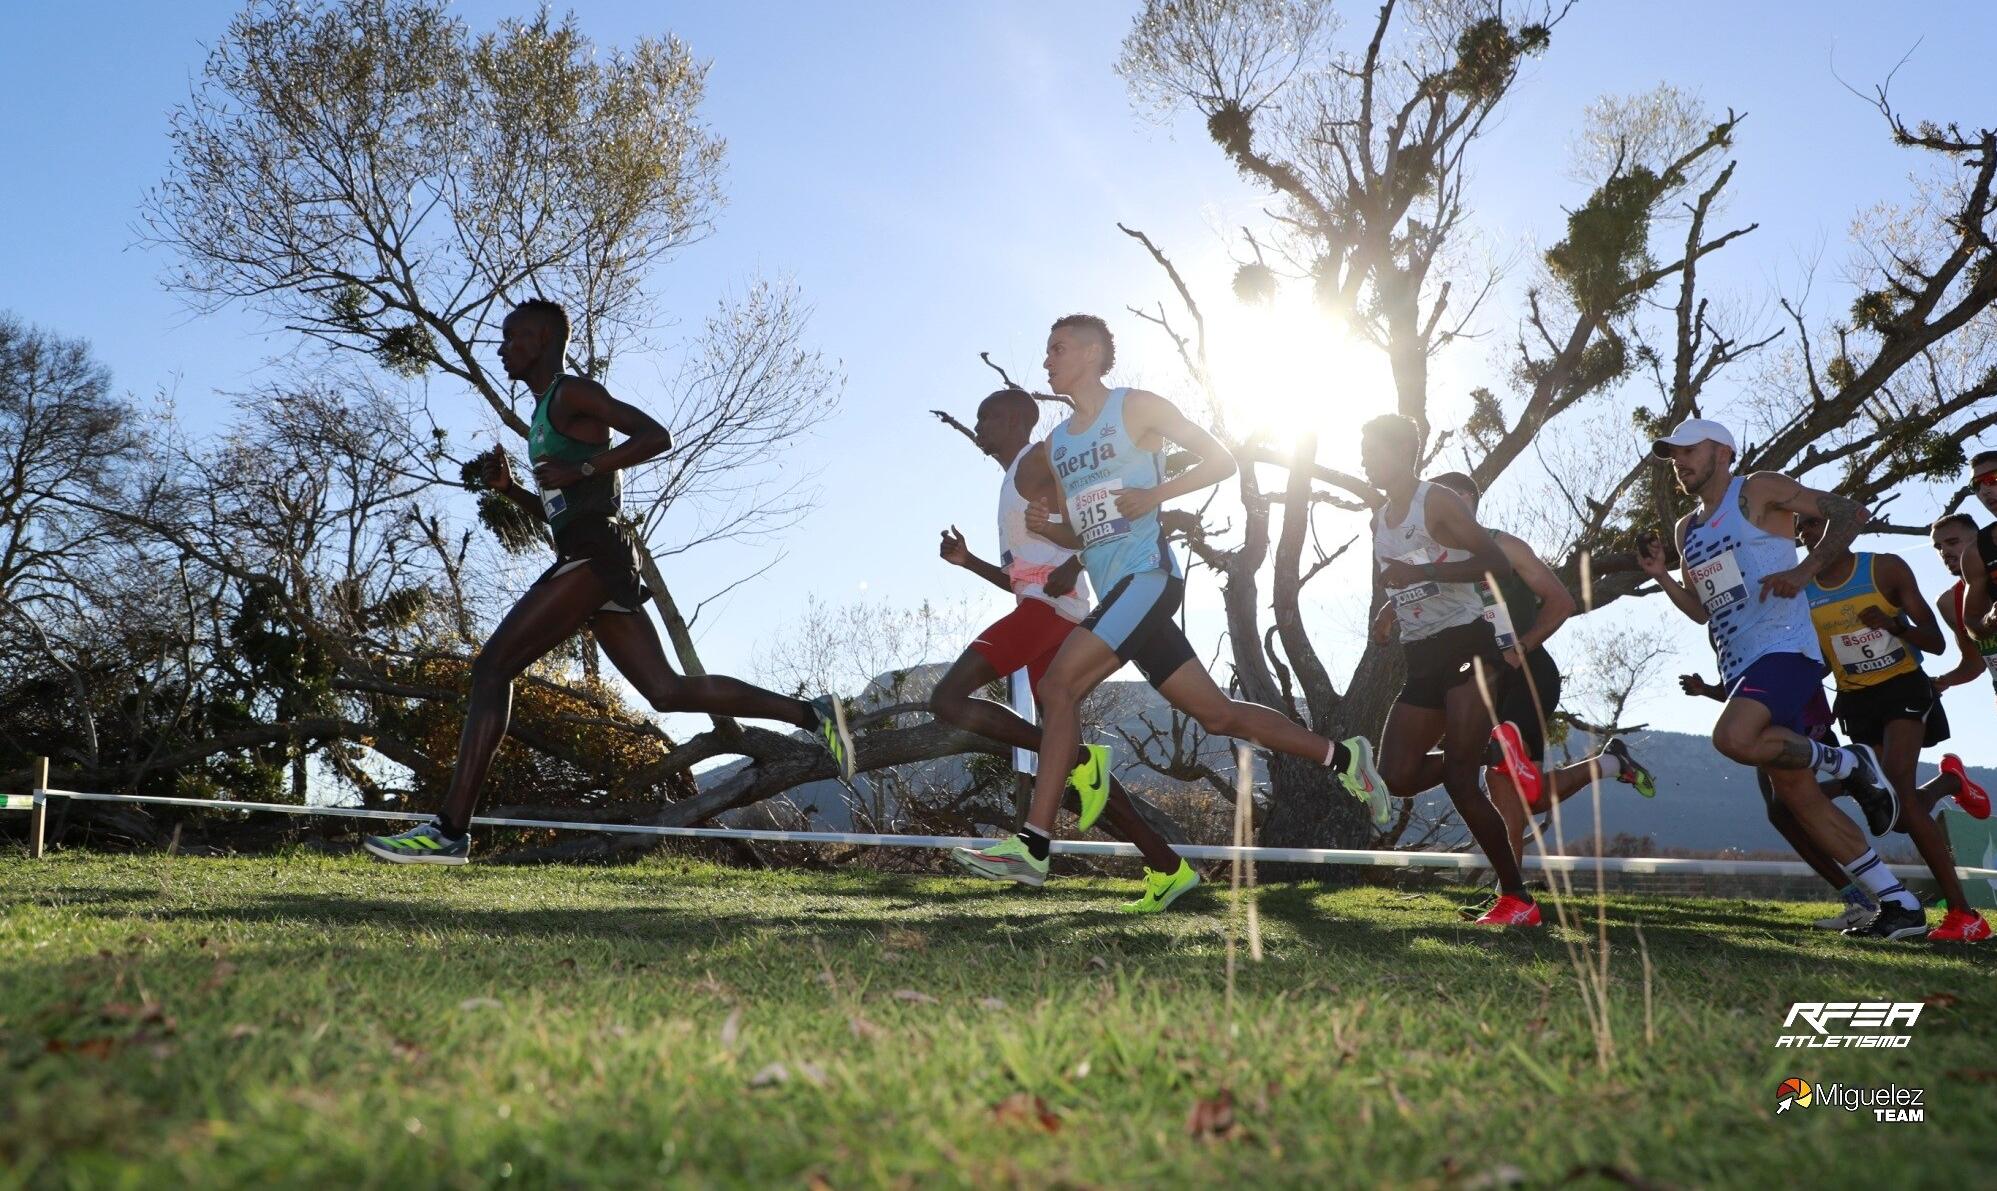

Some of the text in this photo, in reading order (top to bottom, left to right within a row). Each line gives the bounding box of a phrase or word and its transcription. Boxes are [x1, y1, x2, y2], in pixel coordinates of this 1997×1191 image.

[1057, 440, 1117, 479] nerja
[1081, 487, 1108, 508] Soria
[1079, 502, 1107, 530] 315
[1697, 562, 1723, 581] Soria
[1705, 579, 1716, 596] 9
[1852, 629, 1883, 646] Soria
[1861, 644, 1874, 659] 6
